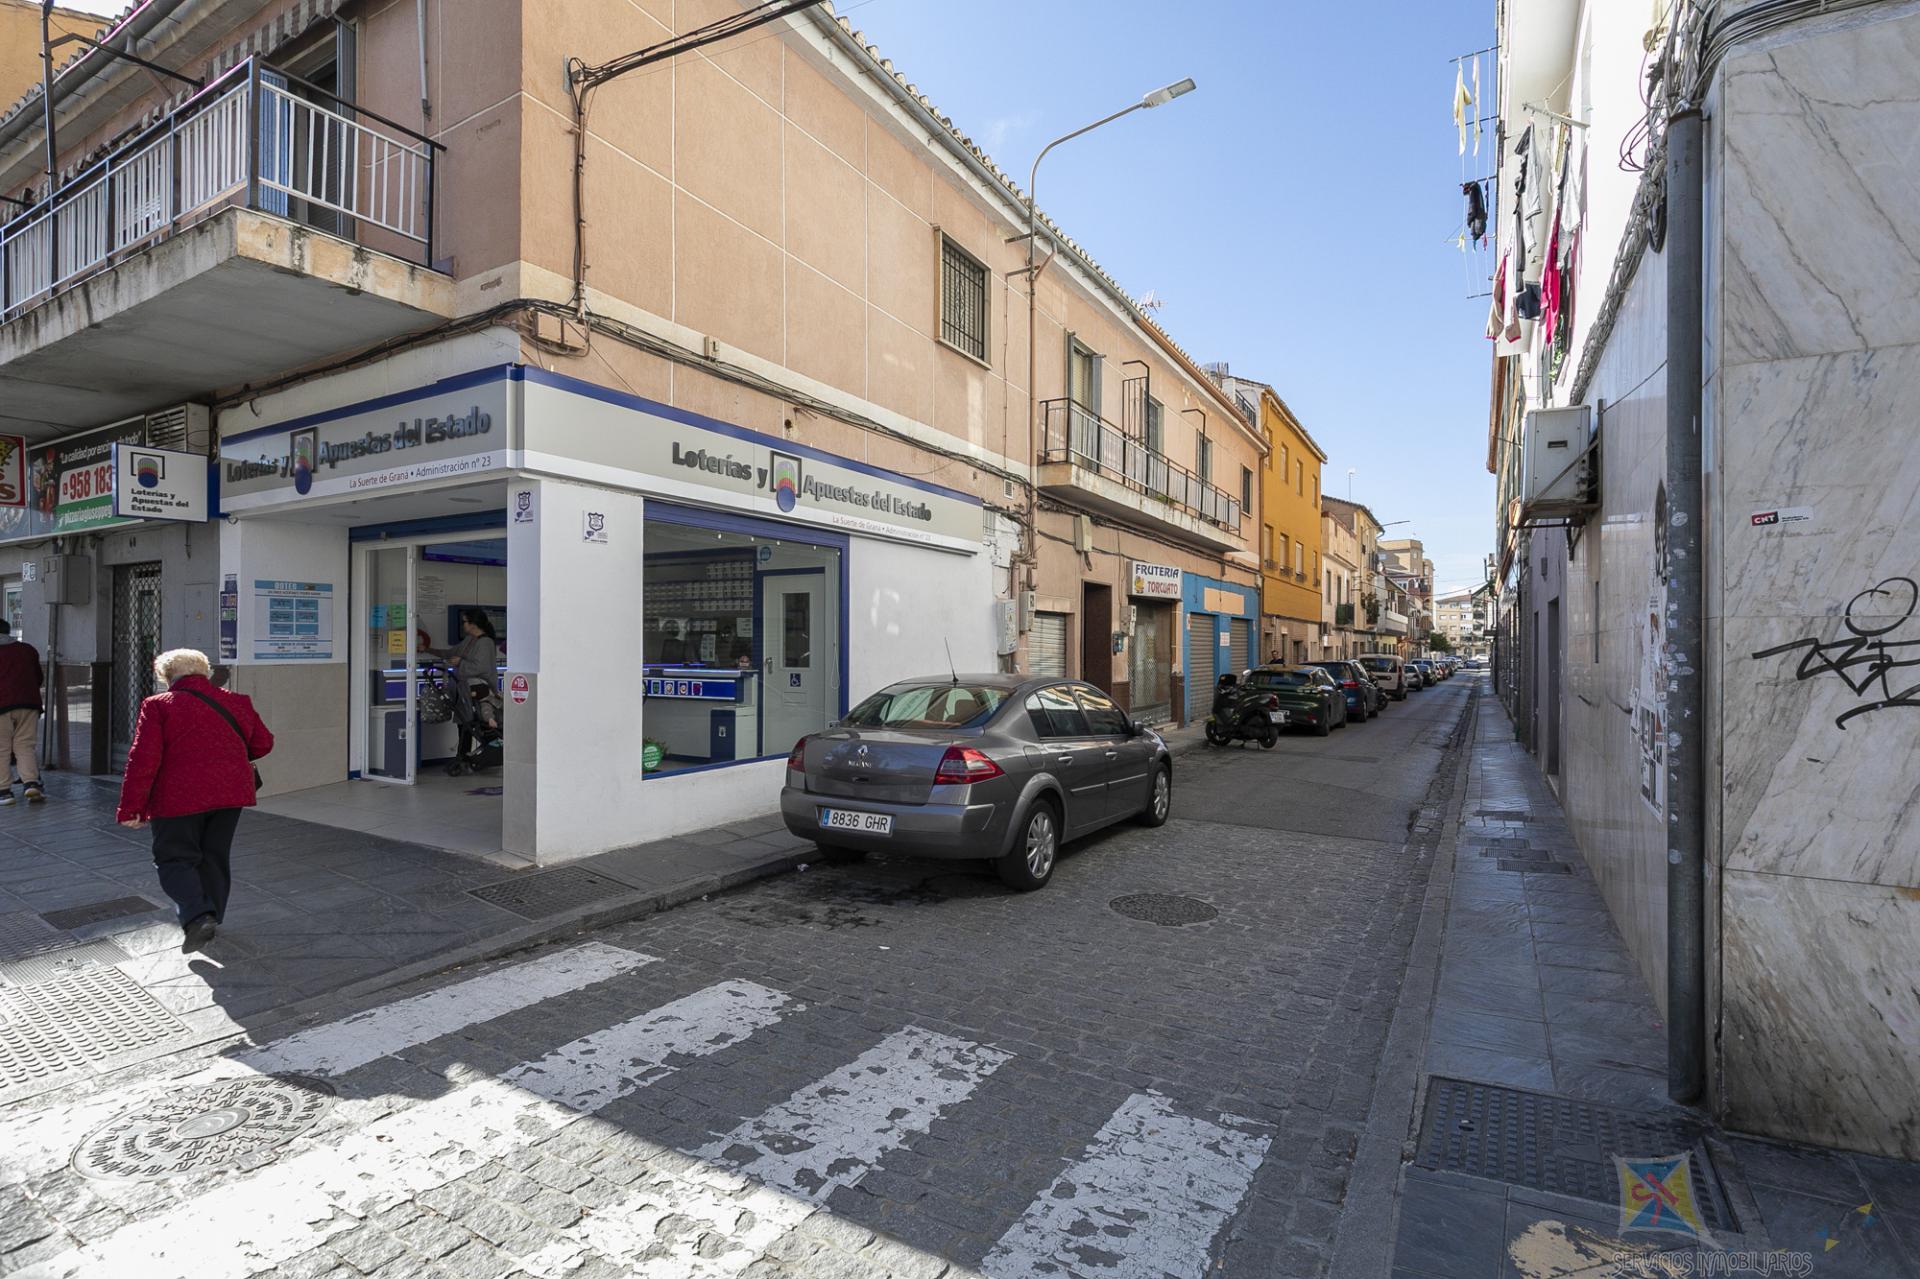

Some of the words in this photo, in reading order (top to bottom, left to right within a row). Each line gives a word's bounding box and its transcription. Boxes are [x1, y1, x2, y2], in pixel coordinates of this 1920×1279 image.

[227, 454, 278, 483] Loterías
[280, 456, 290, 478] y
[319, 431, 391, 469] Apuestas
[393, 418, 422, 450] del
[425, 405, 491, 444] Estado
[69, 470, 91, 500] 958
[93, 463, 112, 495] 183
[349, 480, 357, 489] La
[358, 476, 378, 488] Suerte
[379, 474, 388, 483] de
[389, 471, 409, 482] Grana
[416, 460, 469, 478] Administración
[481, 456, 492, 468] 23
[672, 441, 752, 480] Loterías
[757, 467, 768, 489] y
[803, 474, 870, 508] Apuestas
[871, 490, 892, 513] del
[893, 497, 932, 522] Estado
[131, 496, 174, 507] Apuestas
[175, 500, 189, 508] del
[131, 504, 163, 513] Estado
[1754, 515, 1775, 524] CNT
[1135, 564, 1179, 578] FRUTERIA
[831, 811, 860, 828] 8836
[865, 815, 888, 831] GHR
